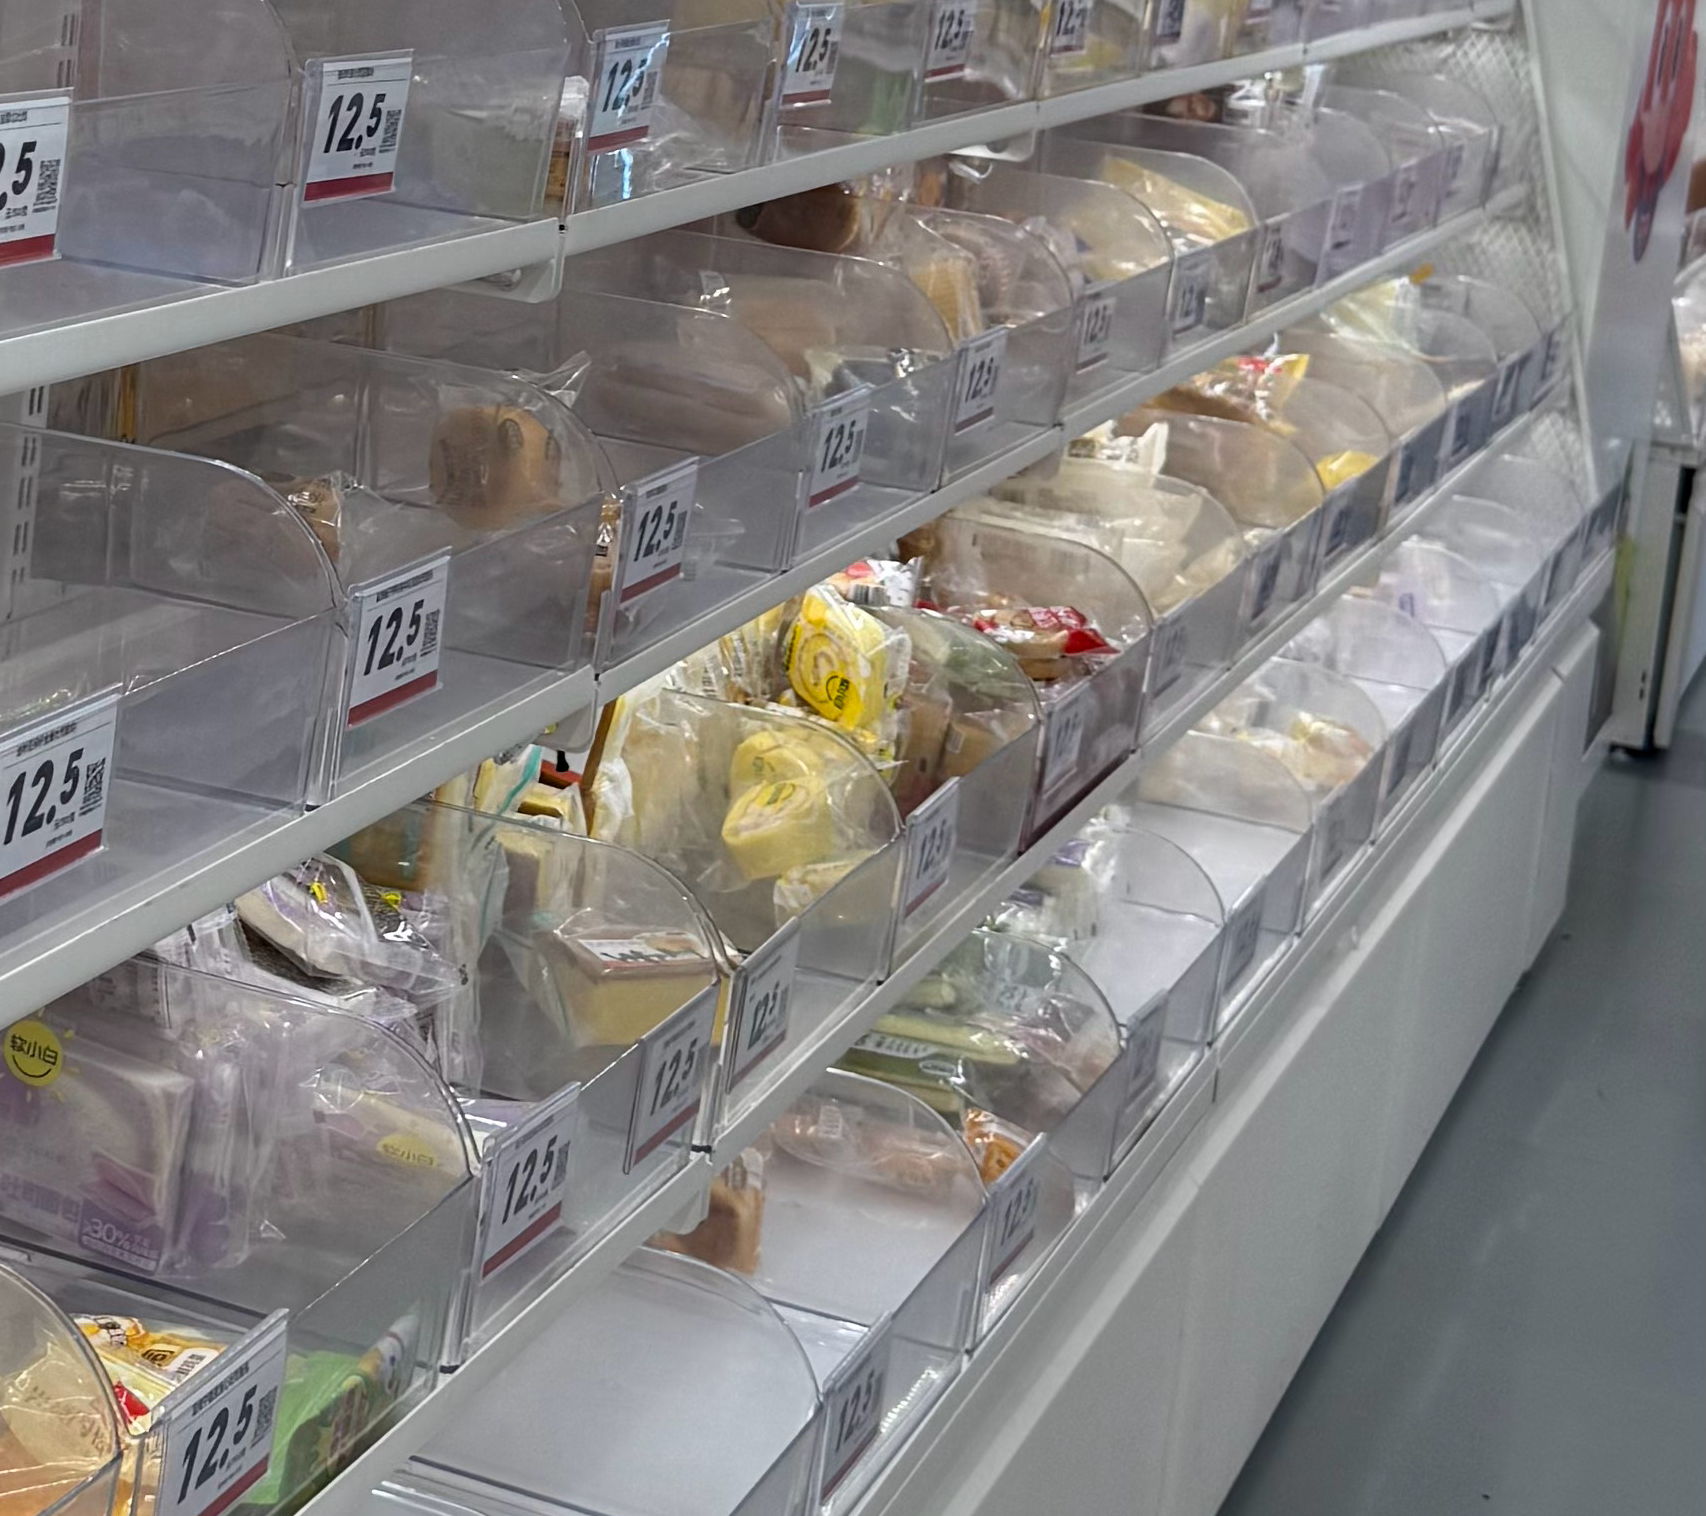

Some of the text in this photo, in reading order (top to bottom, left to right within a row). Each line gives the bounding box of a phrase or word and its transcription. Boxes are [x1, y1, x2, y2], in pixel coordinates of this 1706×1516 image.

[323, 92, 387, 154] 12.5
[821, 420, 857, 474] 12.5
[634, 500, 678, 563] 12.5
[363, 598, 425, 677] 12.5
[2, 747, 85, 846] 12.5
[10, 1033, 59, 1066] 软小白
[502, 1135, 559, 1225] 12.5
[177, 1384, 258, 1506] 12.5
